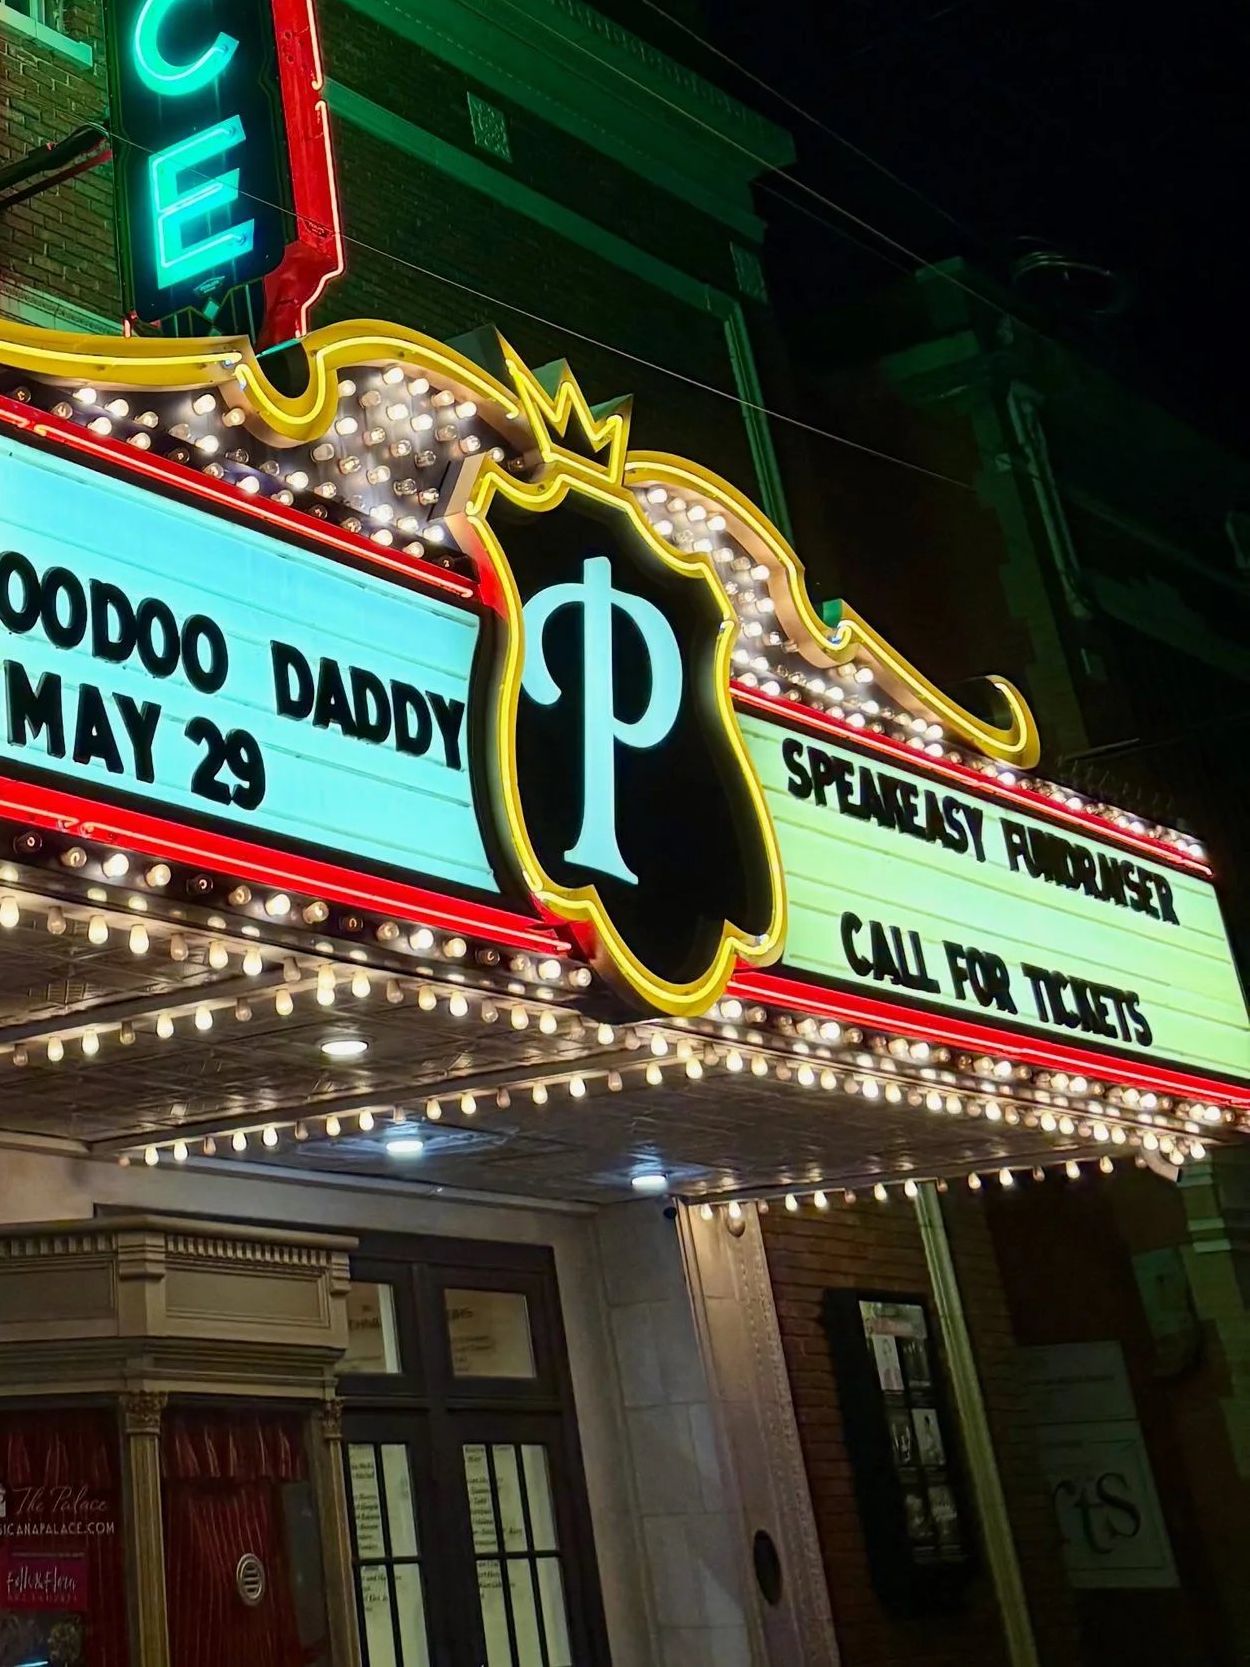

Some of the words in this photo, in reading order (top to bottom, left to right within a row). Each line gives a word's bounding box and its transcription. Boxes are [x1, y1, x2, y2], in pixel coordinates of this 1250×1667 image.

[3, 660, 162, 783] MAY
[183, 717, 266, 811] 29
[269, 640, 466, 771] DADDY
[521, 556, 683, 886] P
[782, 738, 986, 863] SPEAKEASY
[999, 817, 1181, 926] FUNDRAISER
[840, 911, 941, 994] CALL
[942, 940, 1018, 1014] FOR
[1020, 962, 1154, 1047] TICKETS
[11, 1485, 46, 1515] The
[49, 1485, 108, 1513] Palace
